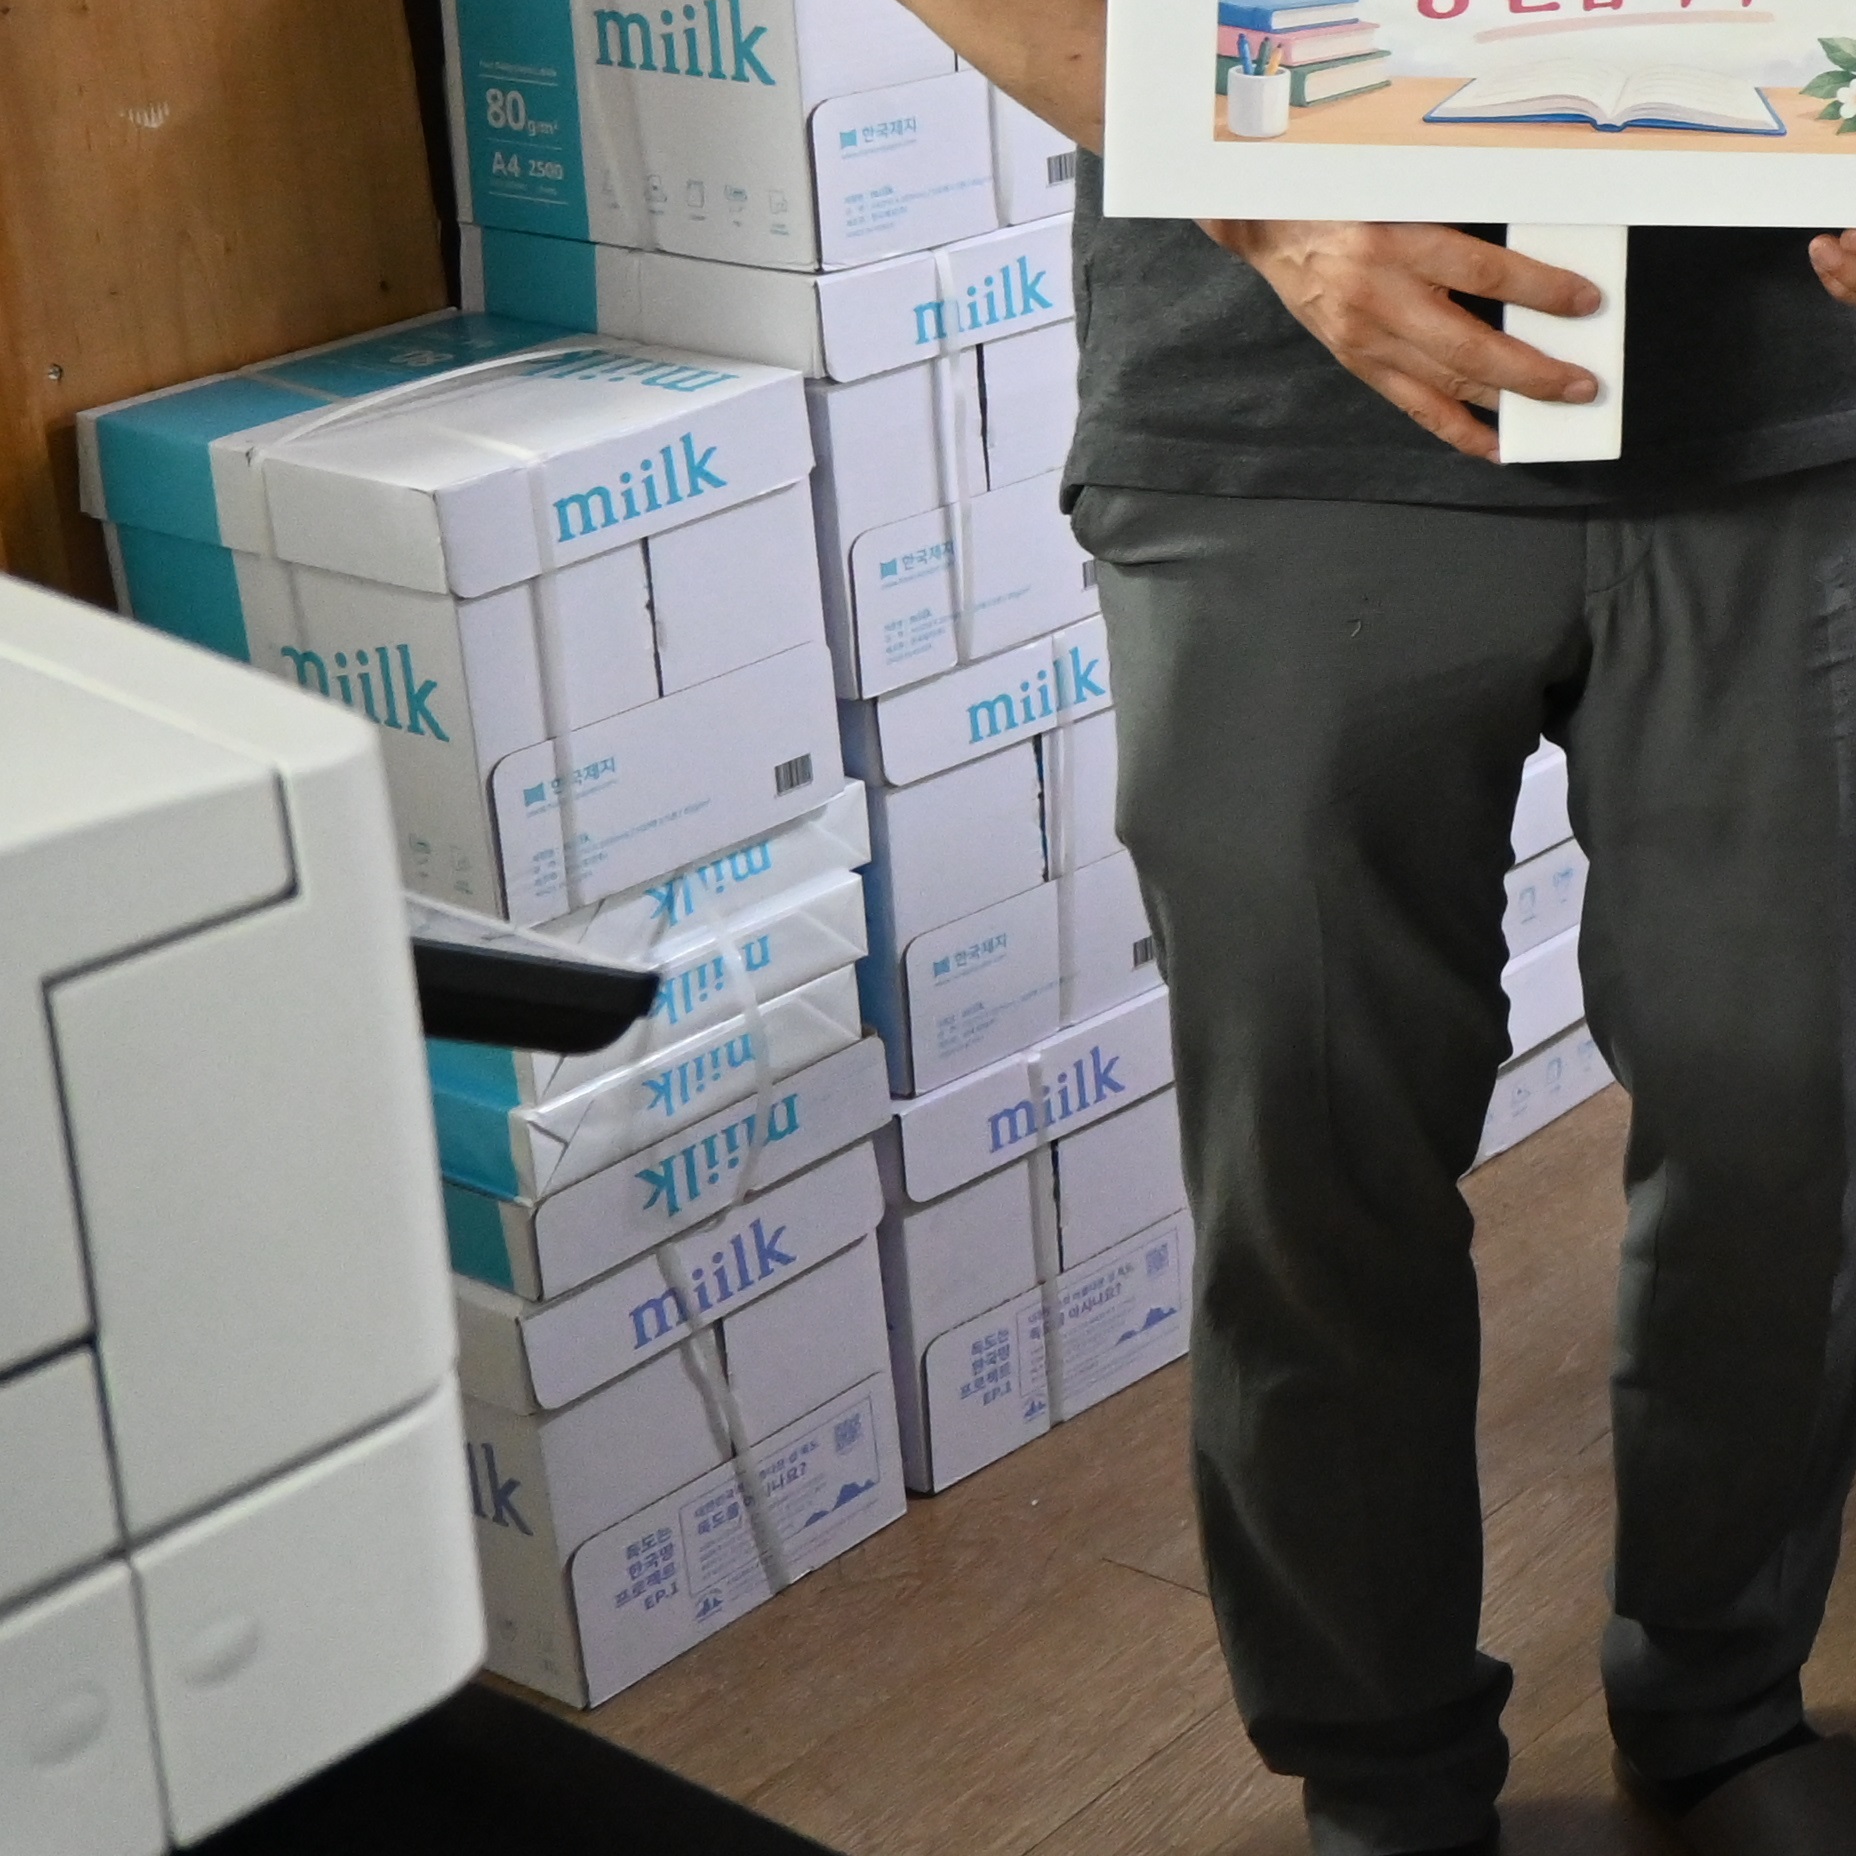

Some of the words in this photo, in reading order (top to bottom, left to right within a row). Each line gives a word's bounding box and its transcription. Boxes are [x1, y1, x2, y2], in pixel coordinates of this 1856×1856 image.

[492, 151, 521, 178] A4
[553, 432, 728, 543] miilk
[967, 647, 1106, 744] miilk
[987, 1045, 1127, 1155] miilk
